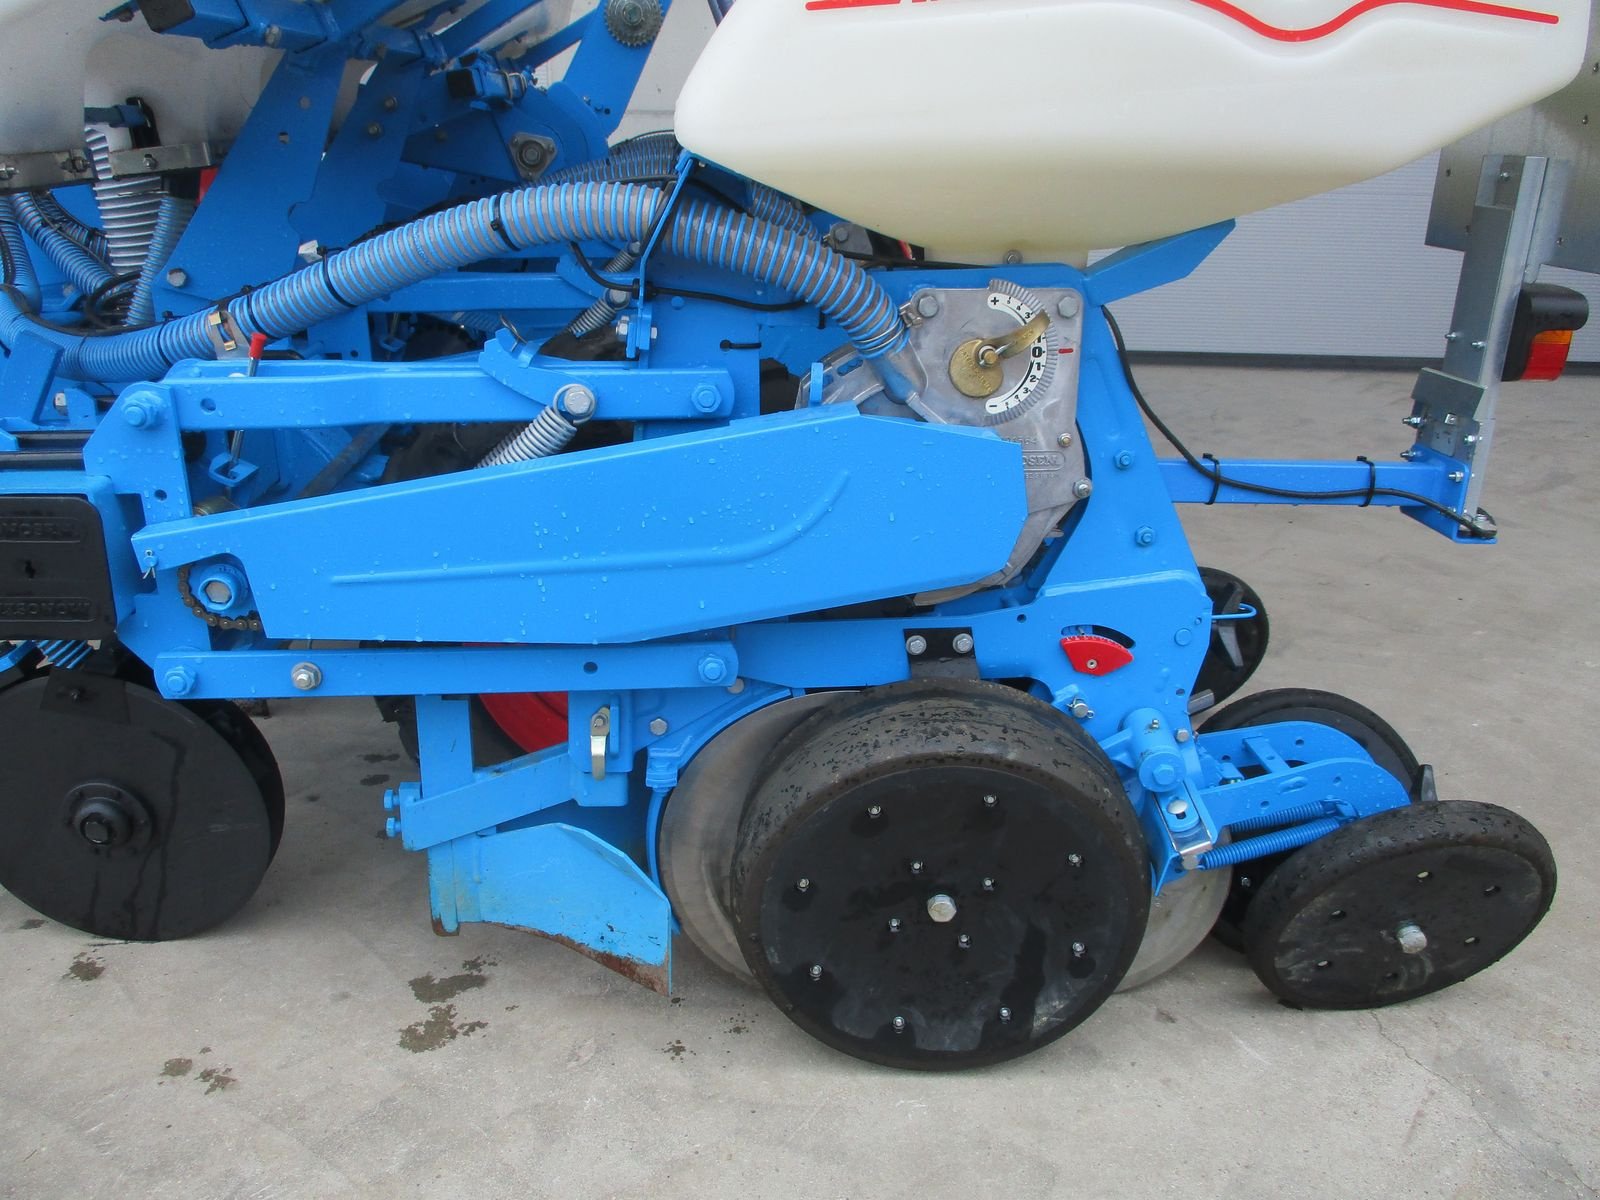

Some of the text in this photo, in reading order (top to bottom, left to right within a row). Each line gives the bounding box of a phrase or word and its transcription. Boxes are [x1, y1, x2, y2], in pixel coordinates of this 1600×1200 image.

[1024, 311, 1031, 319] 3
[1032, 346, 1043, 358] 0
[1035, 362, 1041, 371] 1
[1029, 374, 1037, 383] 2
[1022, 386, 1030, 394] 3
